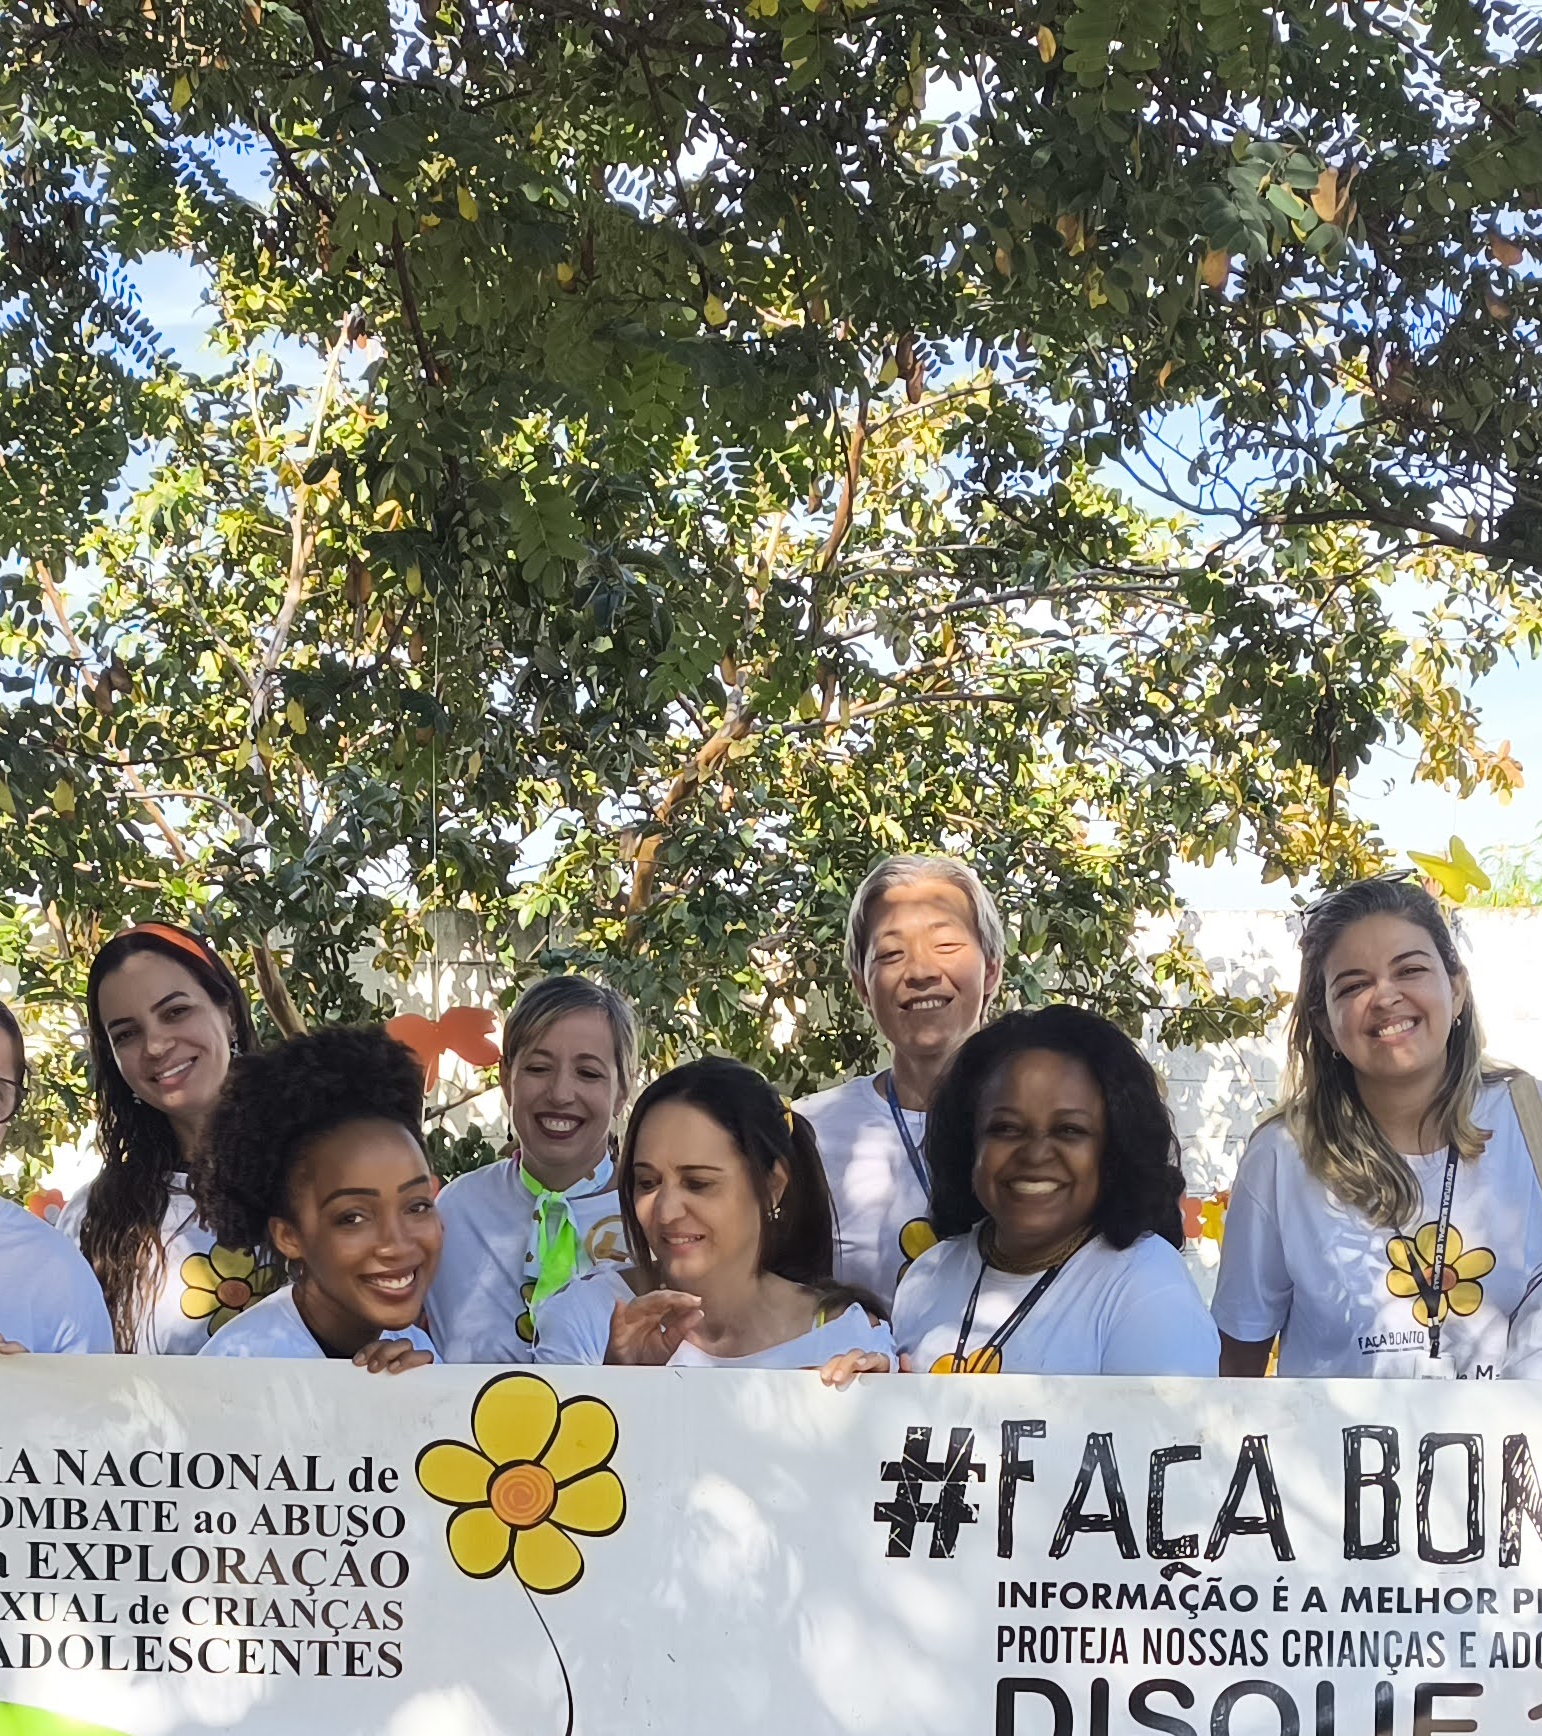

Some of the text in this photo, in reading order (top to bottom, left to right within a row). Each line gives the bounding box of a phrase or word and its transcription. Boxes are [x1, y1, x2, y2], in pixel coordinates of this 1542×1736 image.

[1389, 1331, 1425, 1345] BONITO
[53, 1449, 336, 1493] NACIONAL
[349, 1456, 399, 1494] de
[194, 1511, 237, 1535] ao
[248, 1503, 406, 1539] ABUSO
[26, 1539, 410, 1597] EXPLORAÇÃO
[129, 1595, 170, 1626] de
[182, 1596, 404, 1638] CRIANÇAS
[998, 1577, 1259, 1620] INFORMAÇÃO
[1273, 1576, 1289, 1613] É
[1301, 1587, 1328, 1613] A
[1341, 1587, 1499, 1615] MELHOR
[998, 1626, 1129, 1665] PROTEJA
[1143, 1628, 1269, 1667] NOSSAS
[1283, 1630, 1446, 1676] CRIANÇAS
[1460, 1631, 1477, 1668] E
